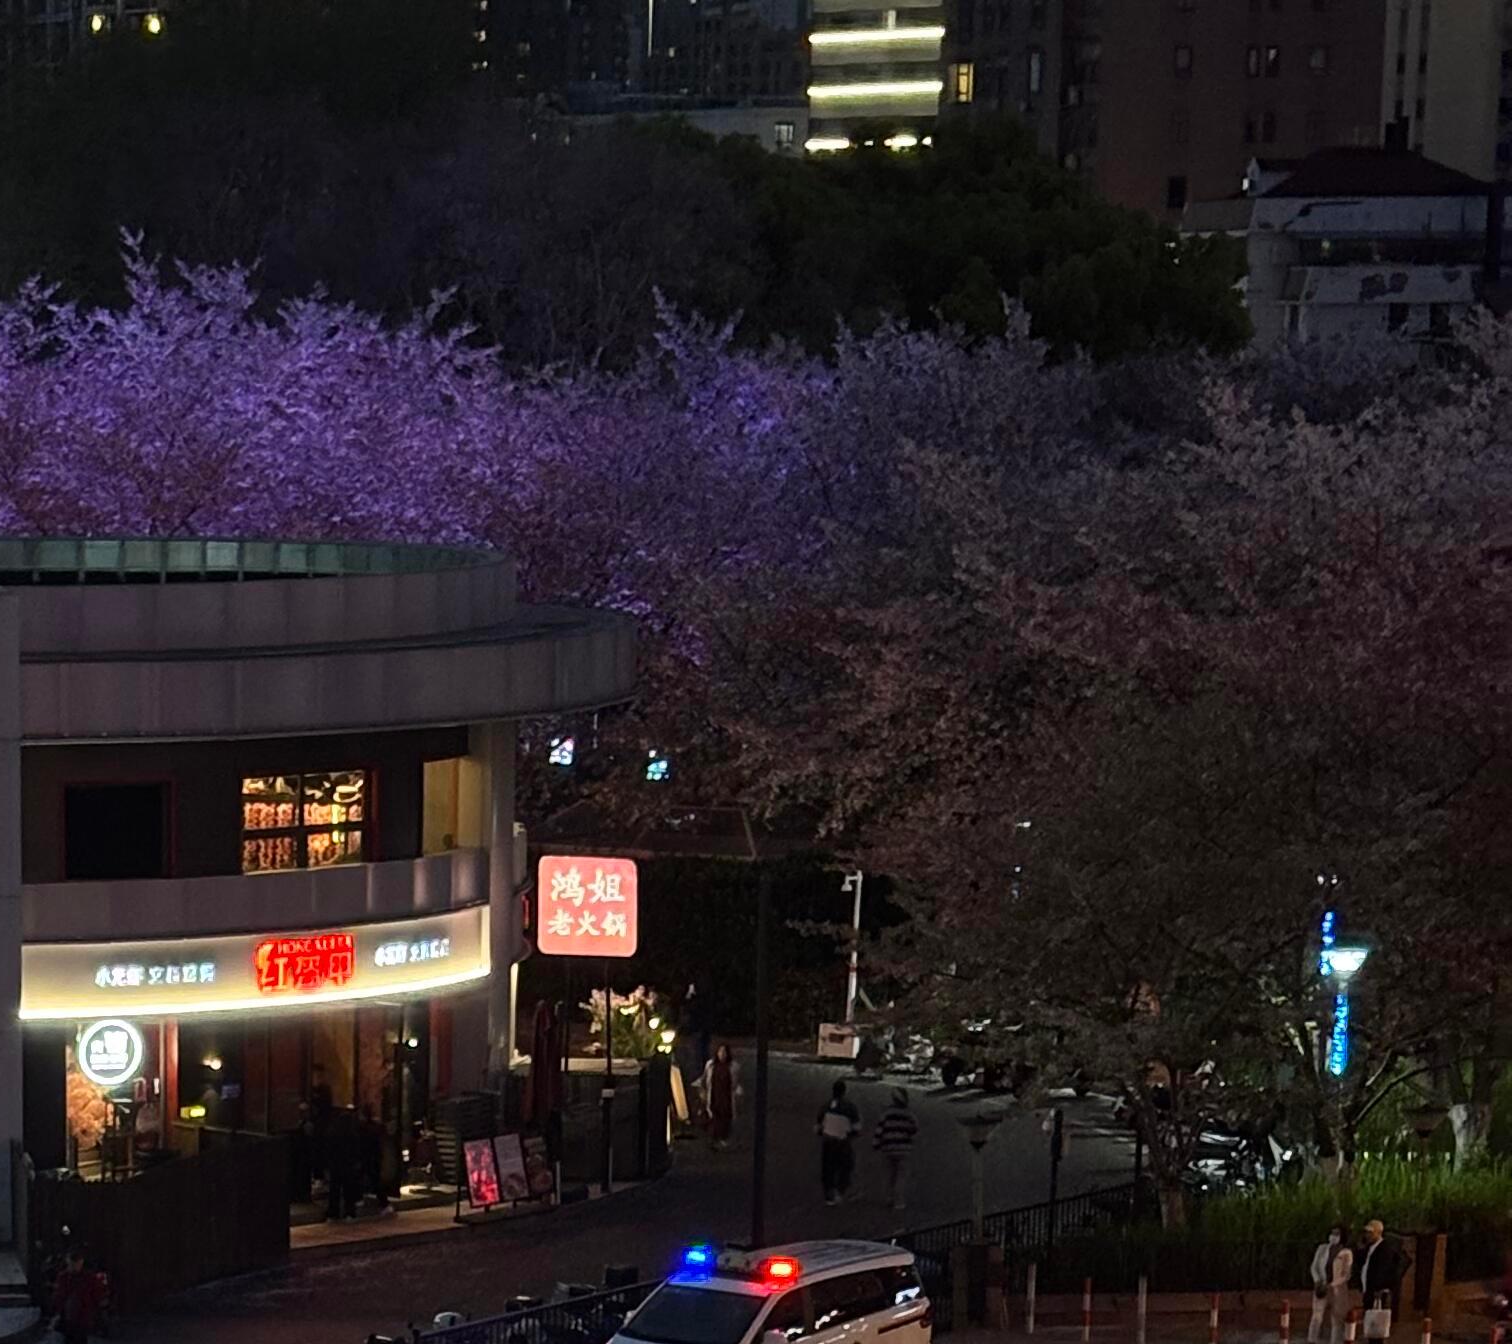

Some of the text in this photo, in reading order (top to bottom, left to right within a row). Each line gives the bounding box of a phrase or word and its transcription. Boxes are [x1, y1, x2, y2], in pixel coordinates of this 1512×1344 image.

[551, 865, 626, 907] 鸿姐
[547, 908, 627, 938] 老火锅
